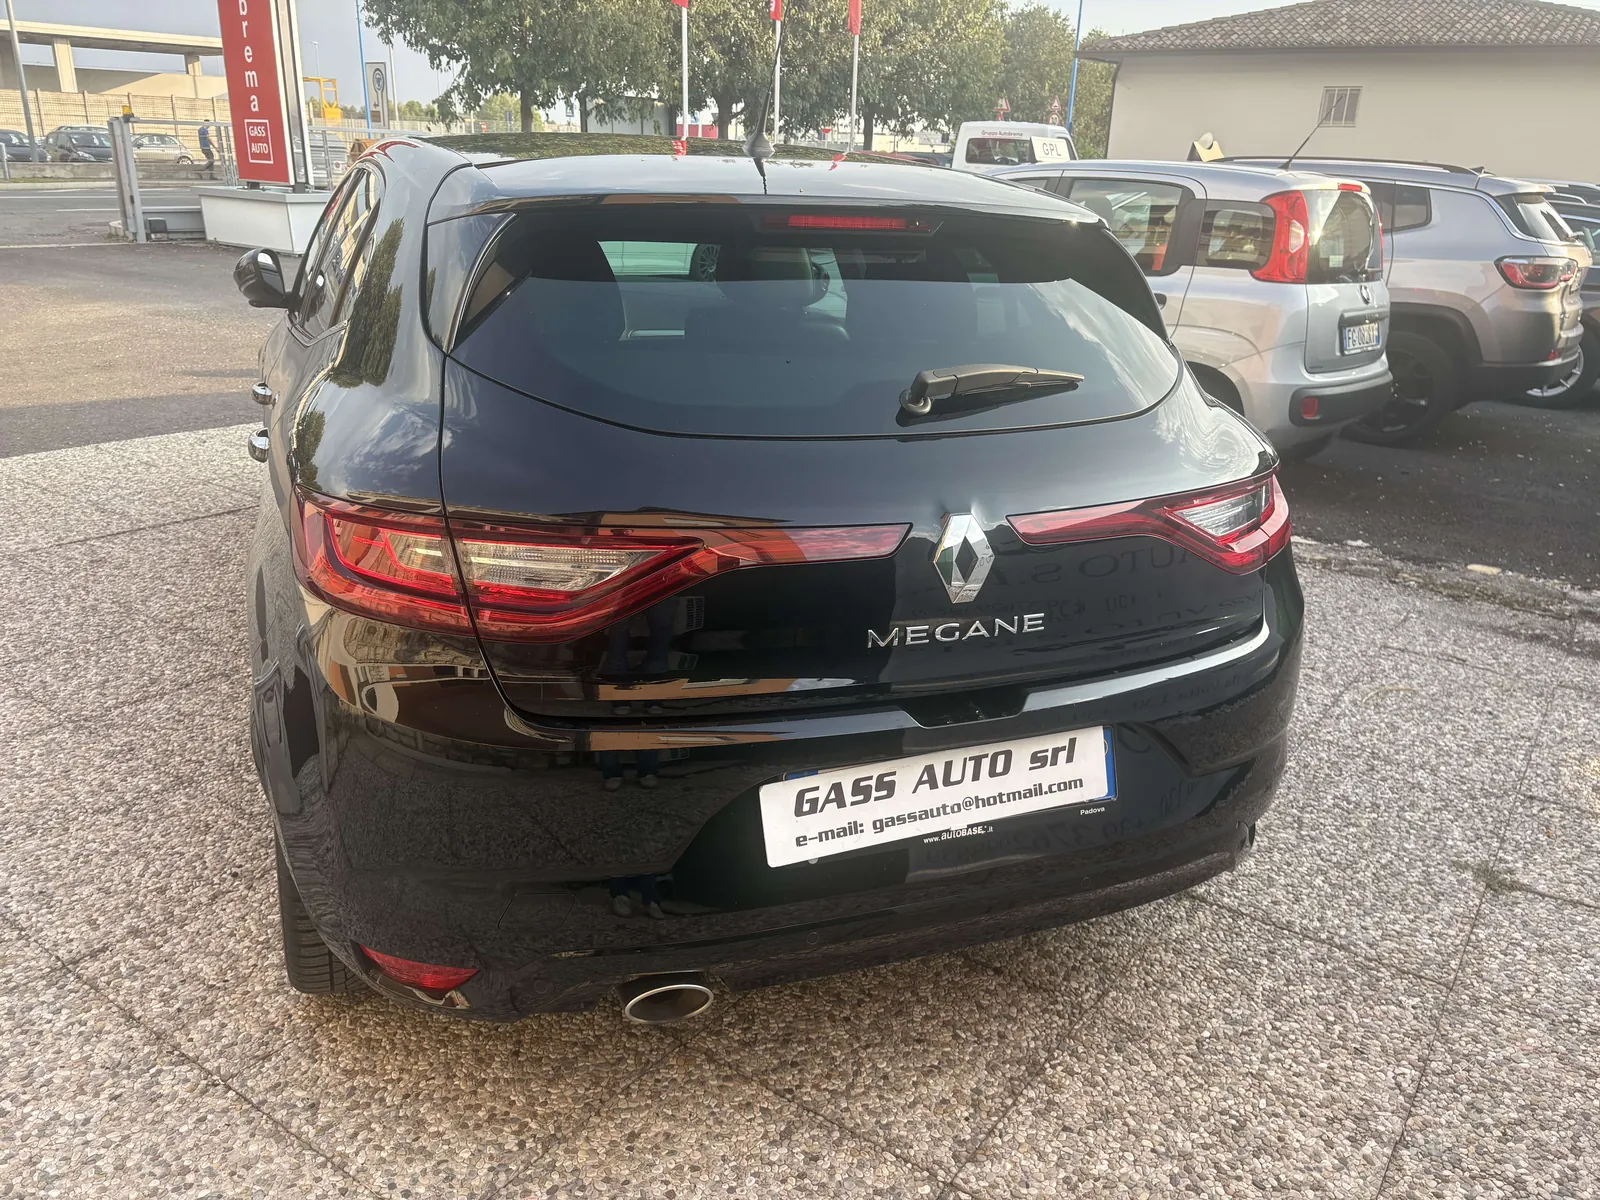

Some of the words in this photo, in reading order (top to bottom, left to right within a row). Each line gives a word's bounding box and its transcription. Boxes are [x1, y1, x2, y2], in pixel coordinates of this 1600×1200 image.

[249, 126, 266, 137] GASS
[251, 143, 269, 154] AUTO
[1042, 142, 1062, 157] GPL
[867, 612, 1045, 649] MEGANE
[793, 770, 897, 819] GASS
[912, 749, 1014, 795] AUTO
[1028, 737, 1078, 772] srl
[795, 820, 865, 848] e-mail:
[872, 776, 1084, 835] gassauto@hotmail.com
[1079, 804, 1106, 816] Padova
